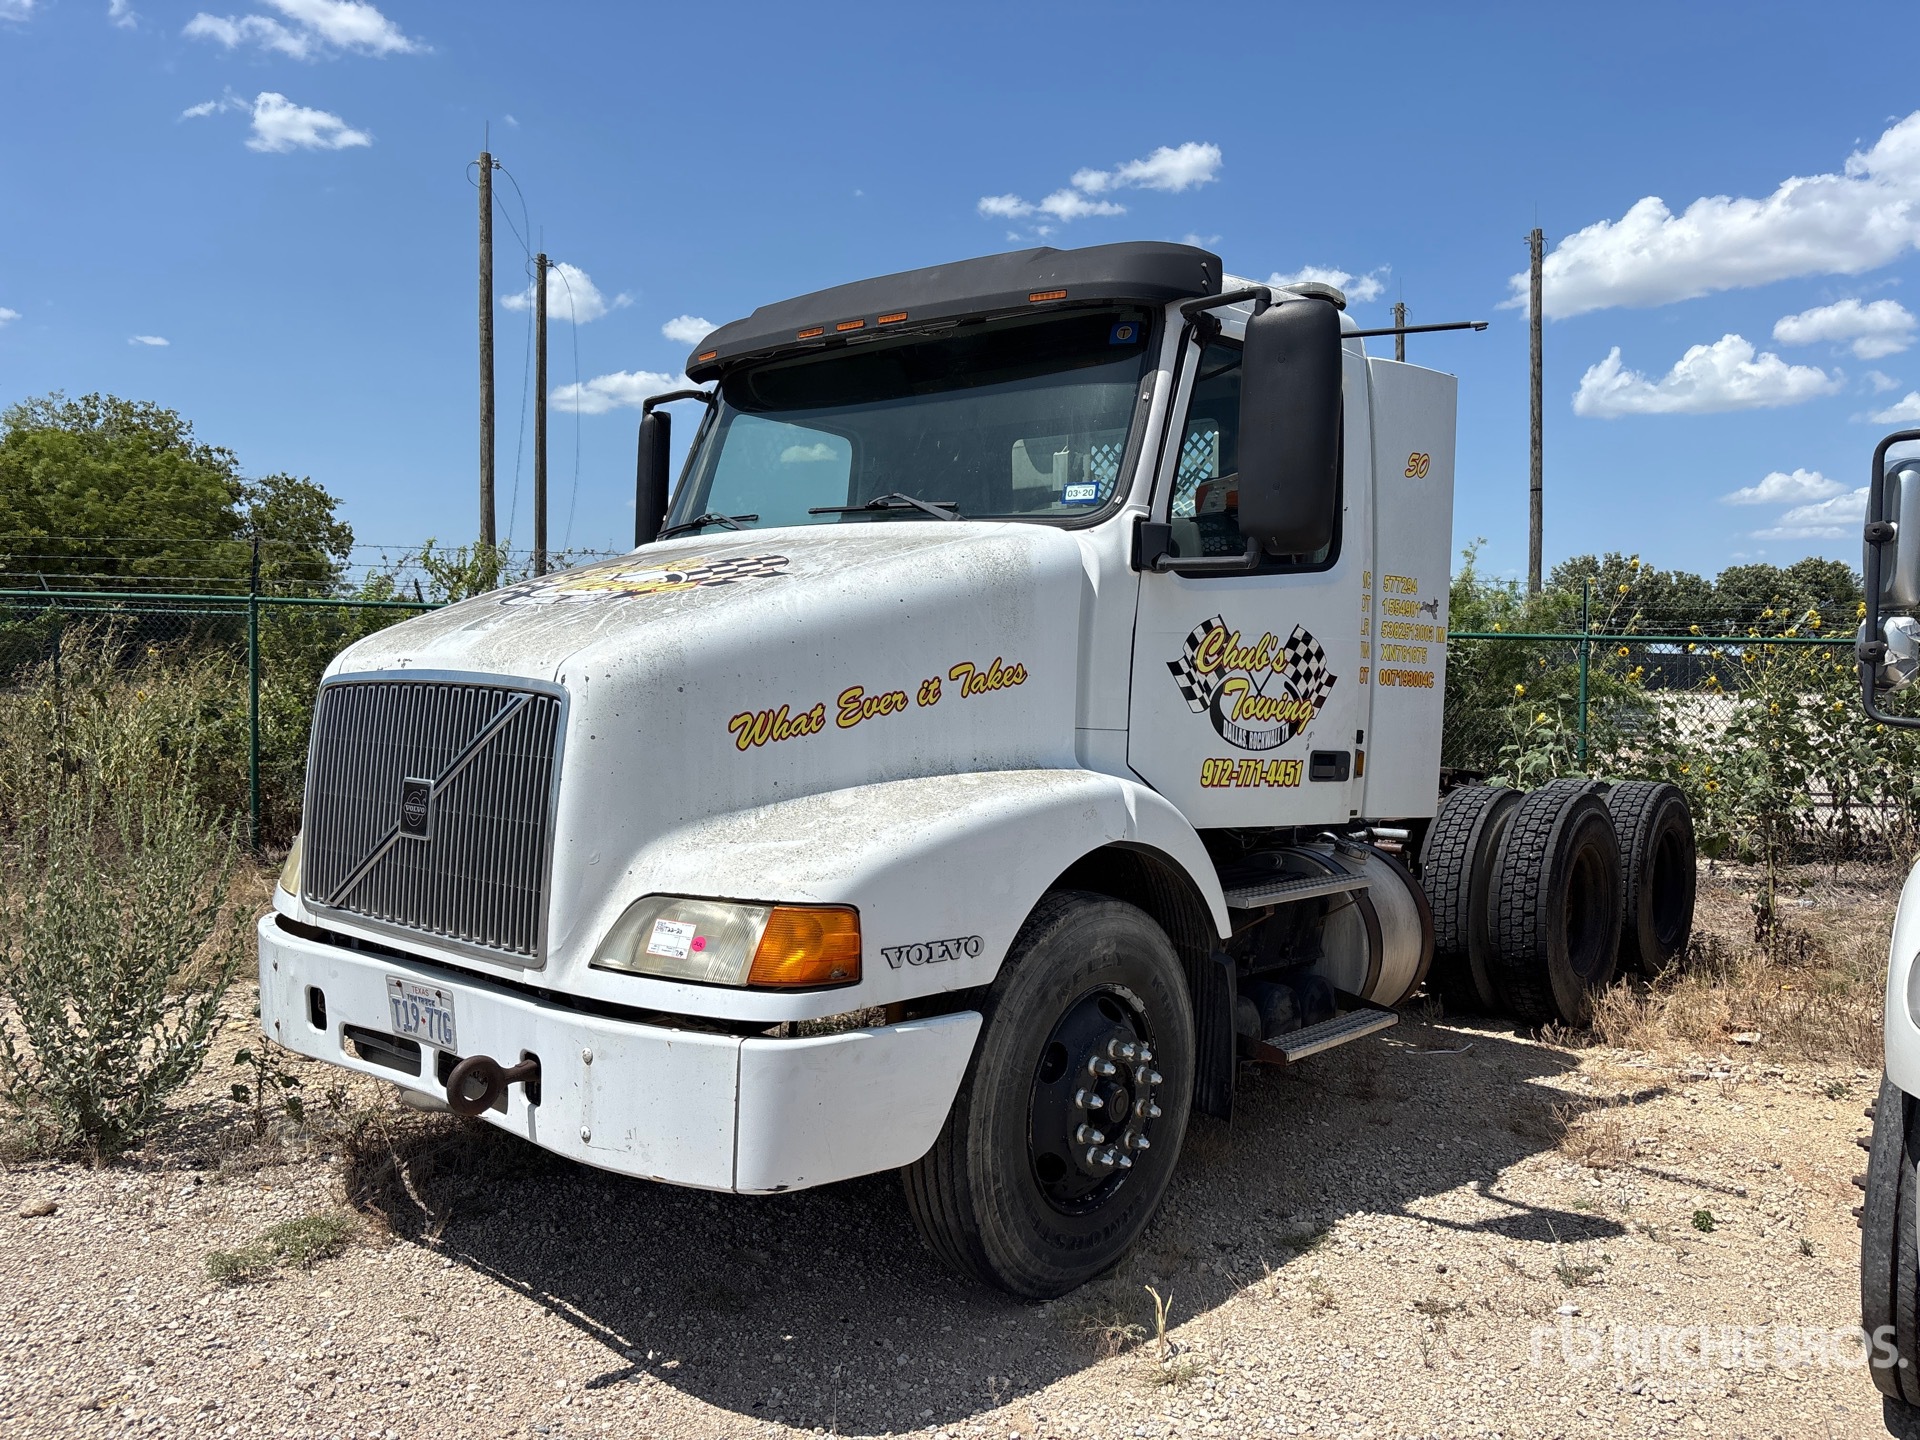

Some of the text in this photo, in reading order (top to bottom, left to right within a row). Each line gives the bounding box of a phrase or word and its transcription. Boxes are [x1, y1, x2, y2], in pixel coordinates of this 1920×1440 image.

[1404, 452, 1430, 479] 50
[1383, 576, 1418, 595] 577294
[1195, 626, 1287, 673] Chub's
[728, 656, 1028, 751] What Ever it Takes
[1223, 676, 1315, 735] Towing
[1223, 719, 1290, 750] DALLAS, ROCKWALL TX
[1201, 758, 1304, 788] 972-771-4451
[405, 804, 425, 814] VOLVO
[881, 935, 985, 969] VOLVO
[411, 986, 429, 996] TEXAS
[392, 997, 419, 1033] T19
